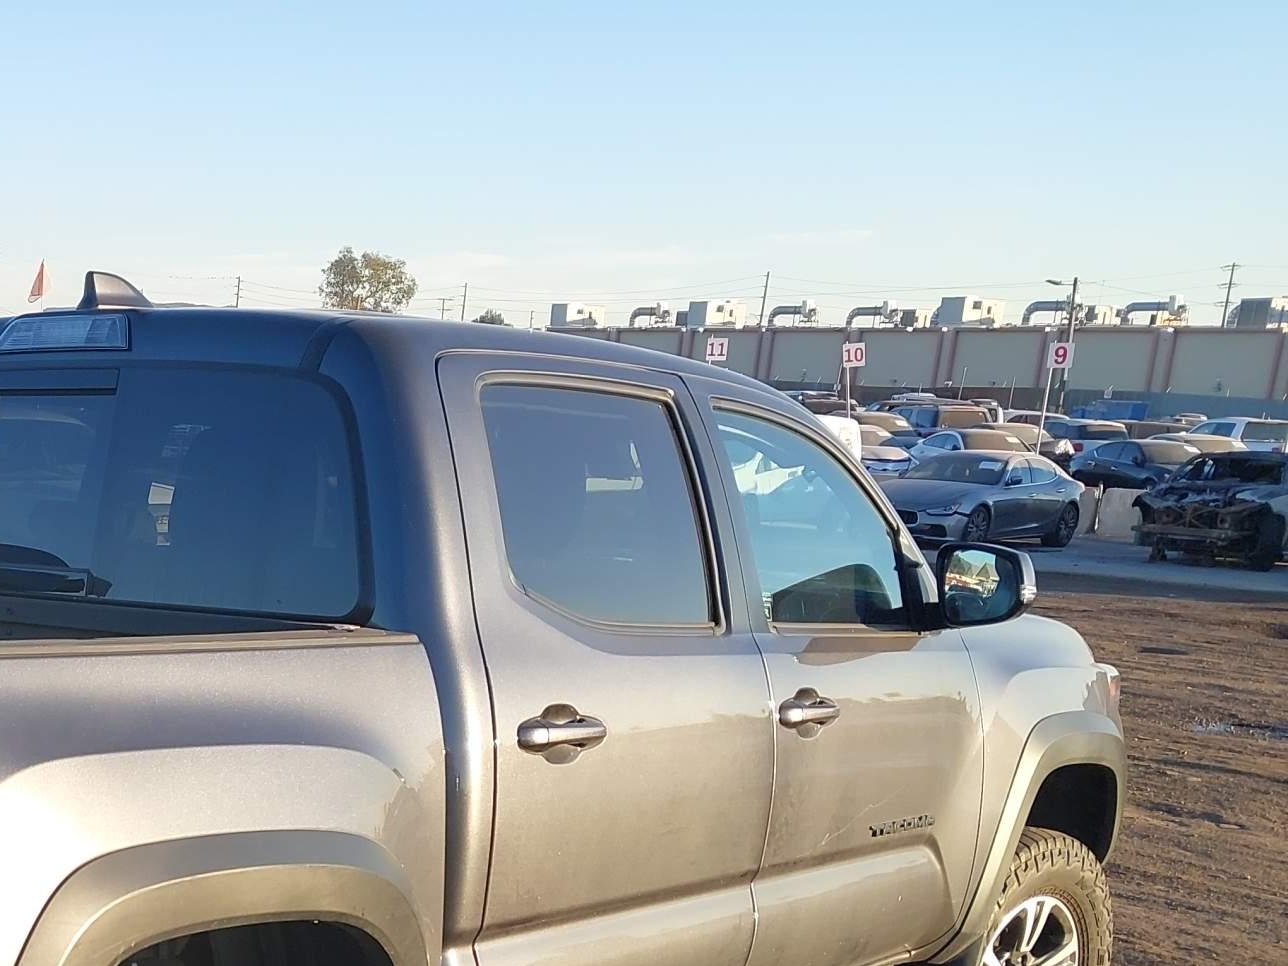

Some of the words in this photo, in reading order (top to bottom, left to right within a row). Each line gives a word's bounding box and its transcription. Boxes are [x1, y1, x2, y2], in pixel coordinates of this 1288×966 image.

[707, 342, 725, 356] 11
[844, 347, 864, 363] 10
[1054, 346, 1068, 364] 9
